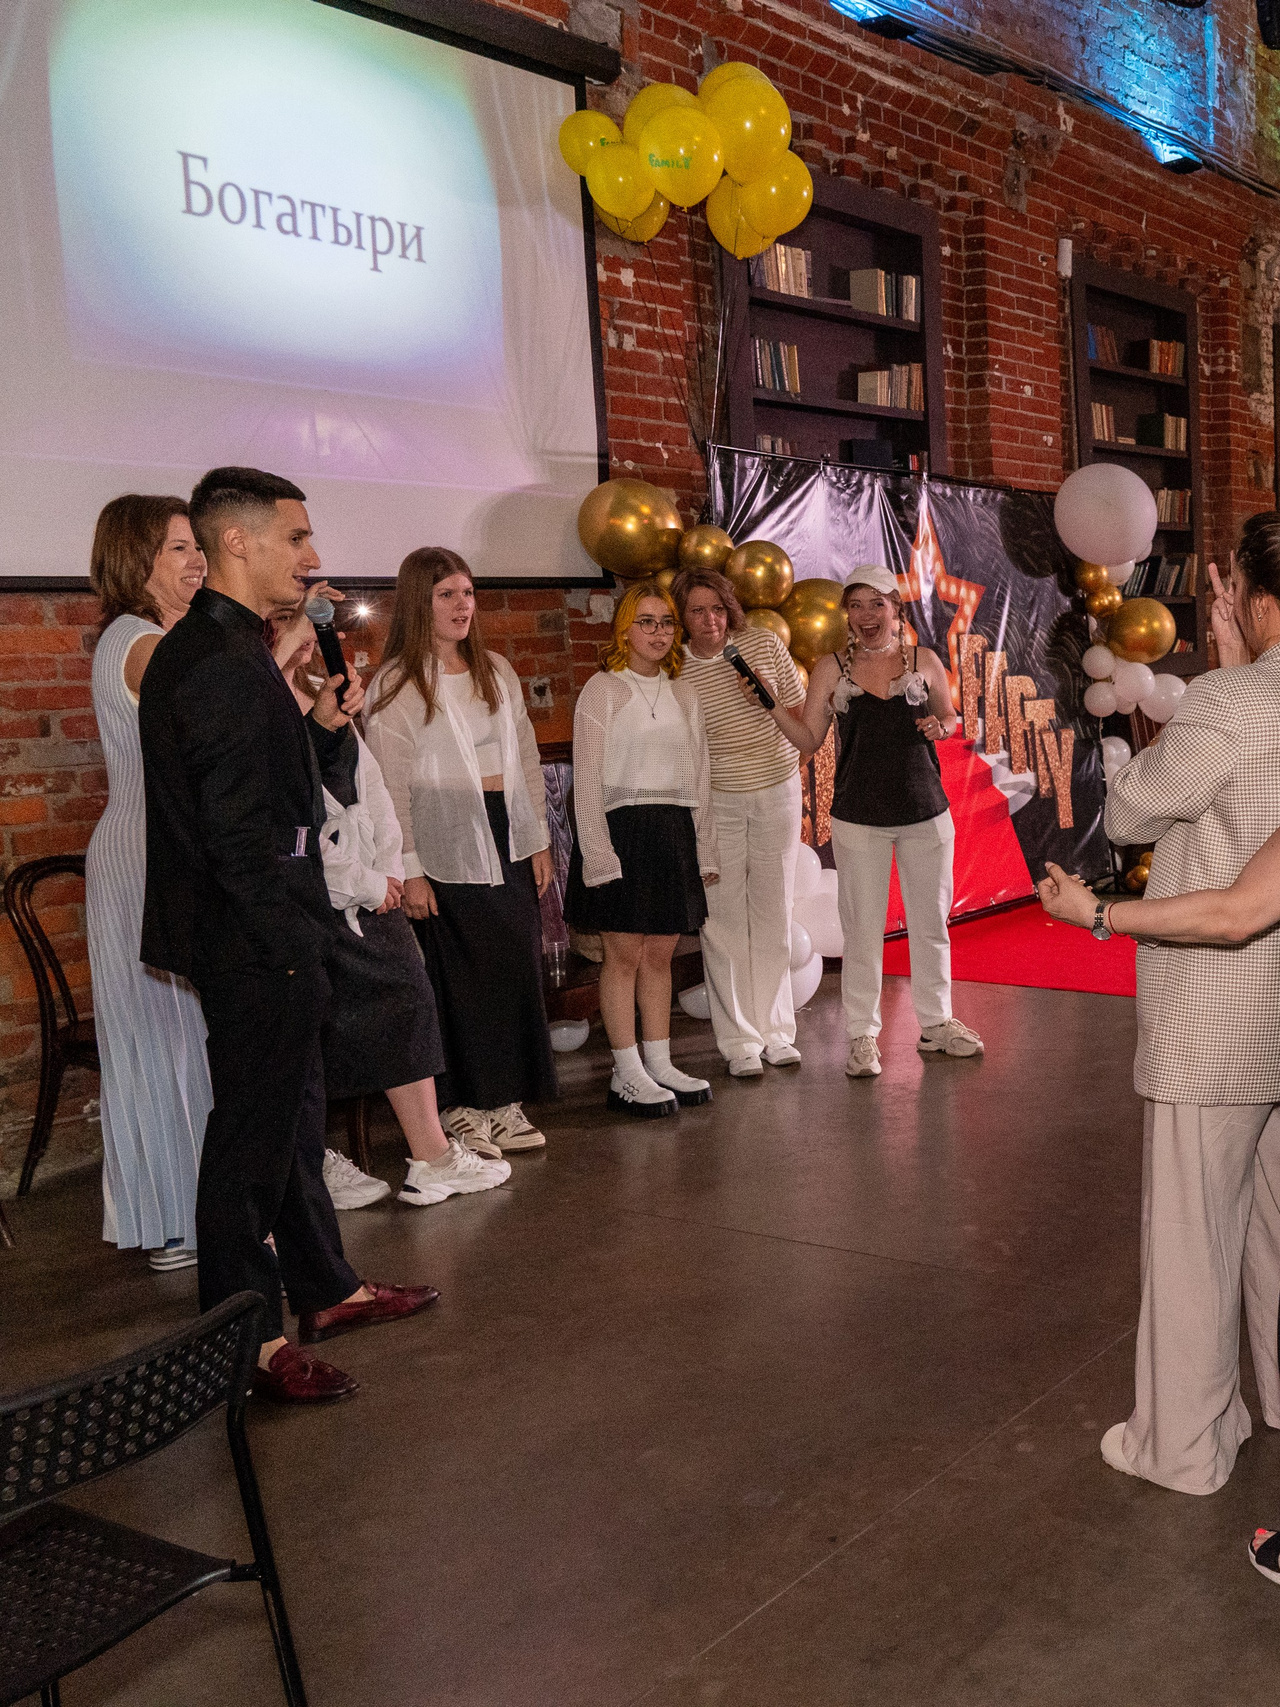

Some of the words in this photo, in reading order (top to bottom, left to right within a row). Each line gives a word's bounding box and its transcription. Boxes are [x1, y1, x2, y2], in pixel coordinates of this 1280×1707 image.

[177, 150, 427, 273] Богатыри
[648, 153, 692, 170] FAMILY
[959, 634, 1075, 830] PARTY
